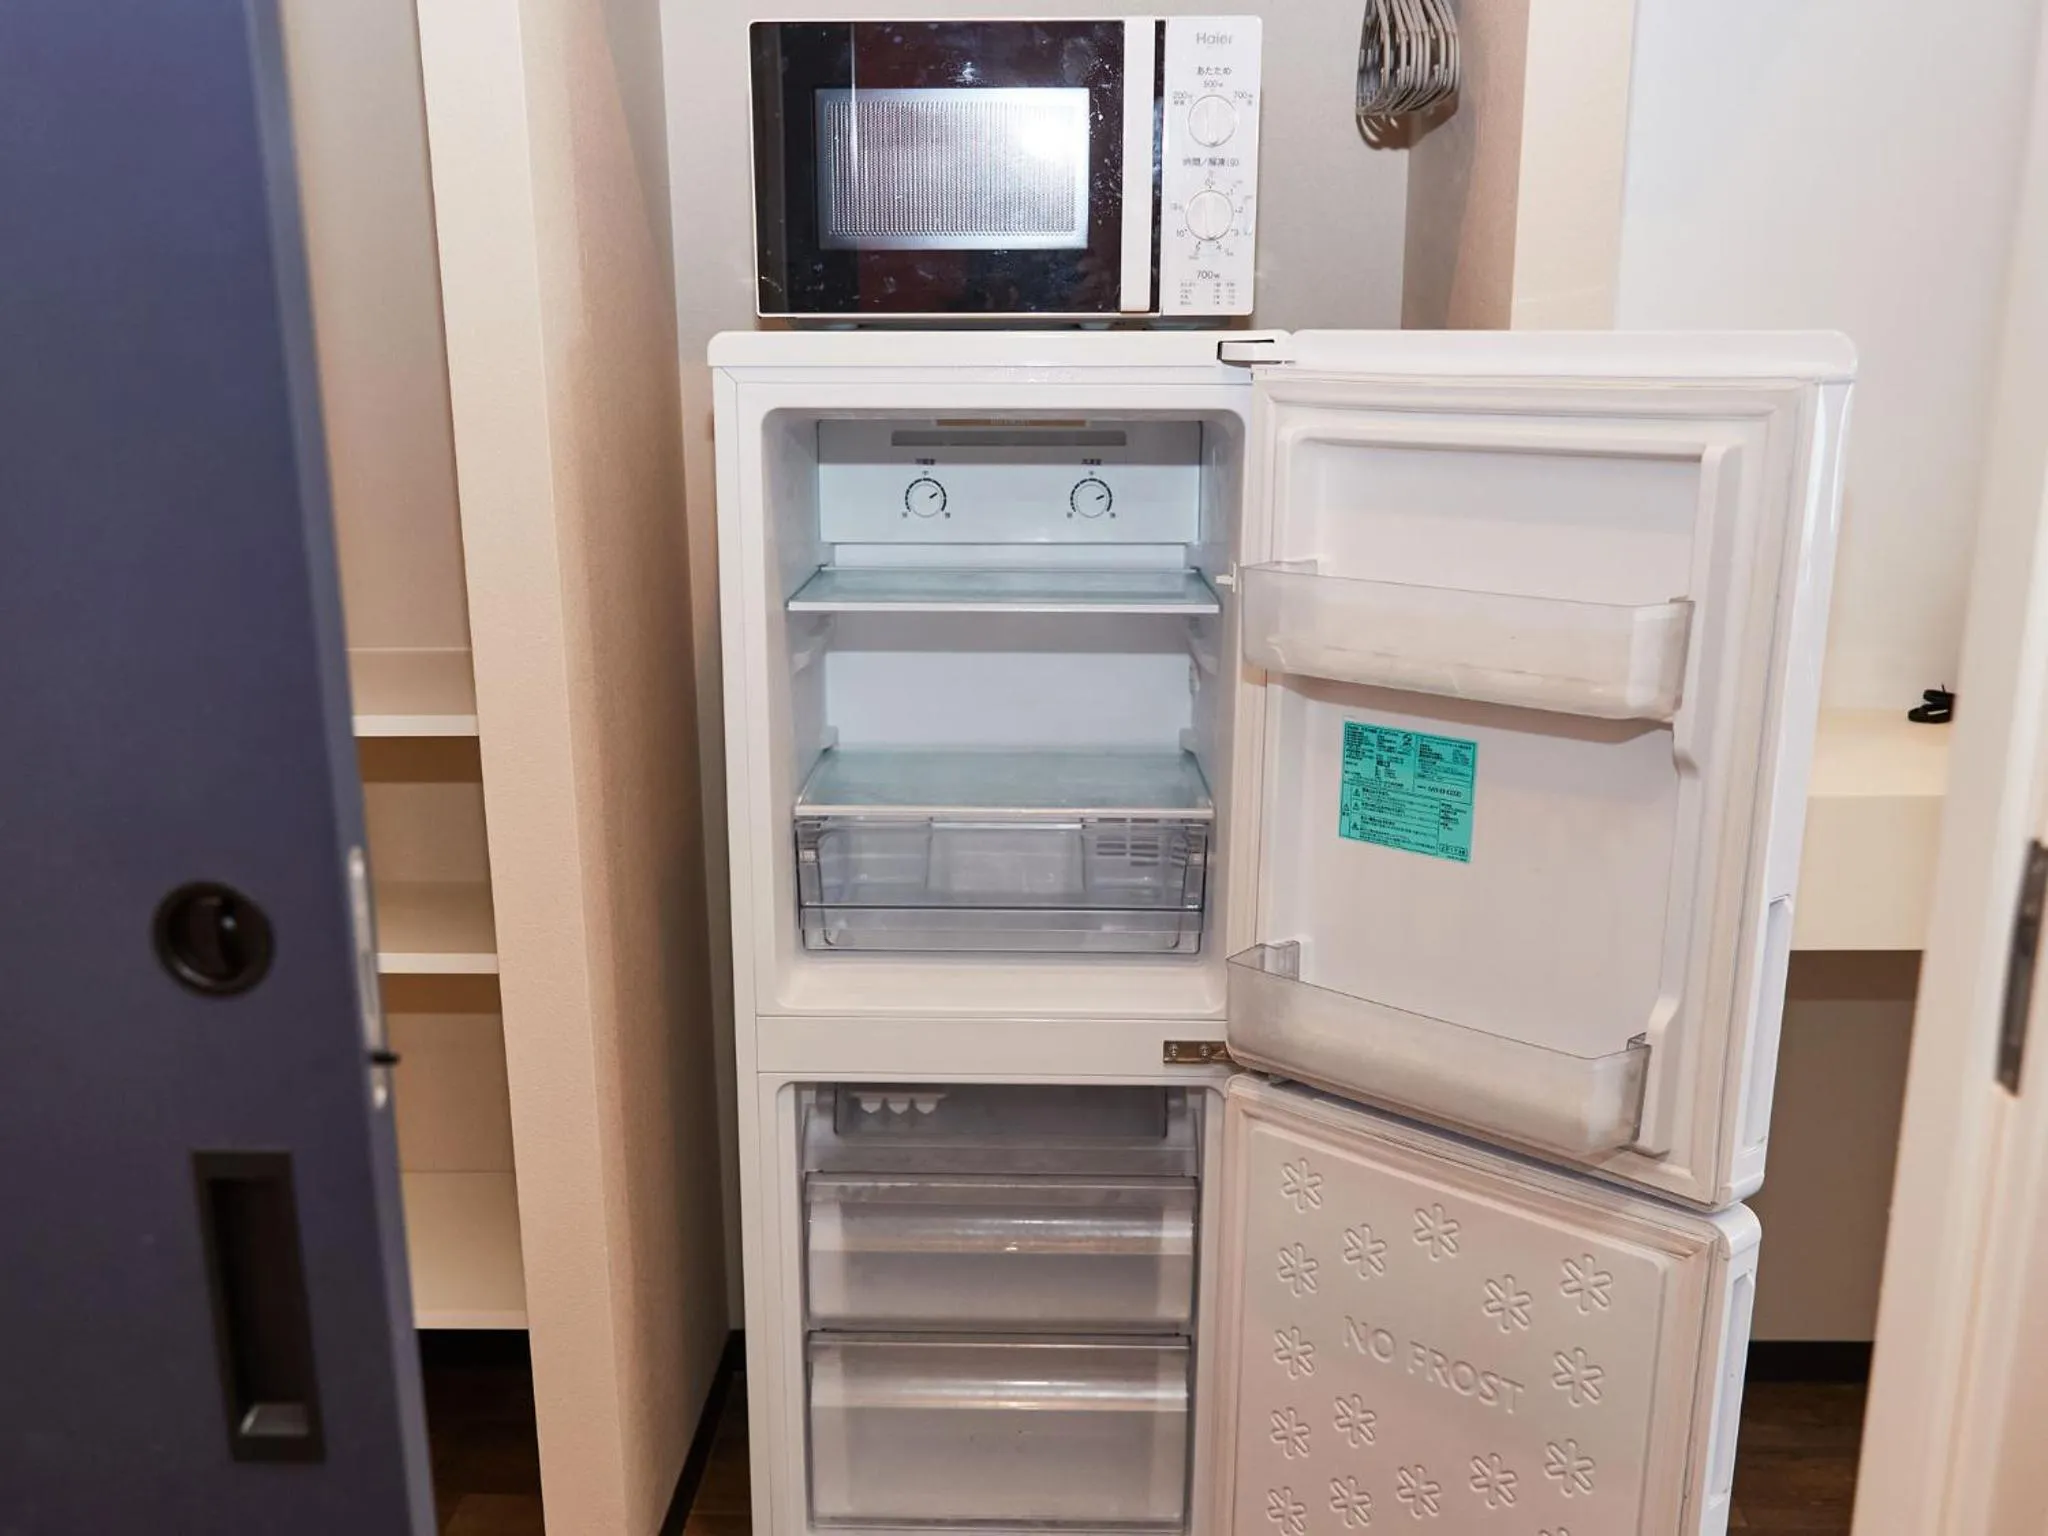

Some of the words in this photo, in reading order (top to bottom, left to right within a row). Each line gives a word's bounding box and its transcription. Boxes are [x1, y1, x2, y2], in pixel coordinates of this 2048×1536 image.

[1196, 32, 1233, 45] Haier
[1344, 1315, 1395, 1363] NO
[1407, 1340, 1525, 1414] FROST
